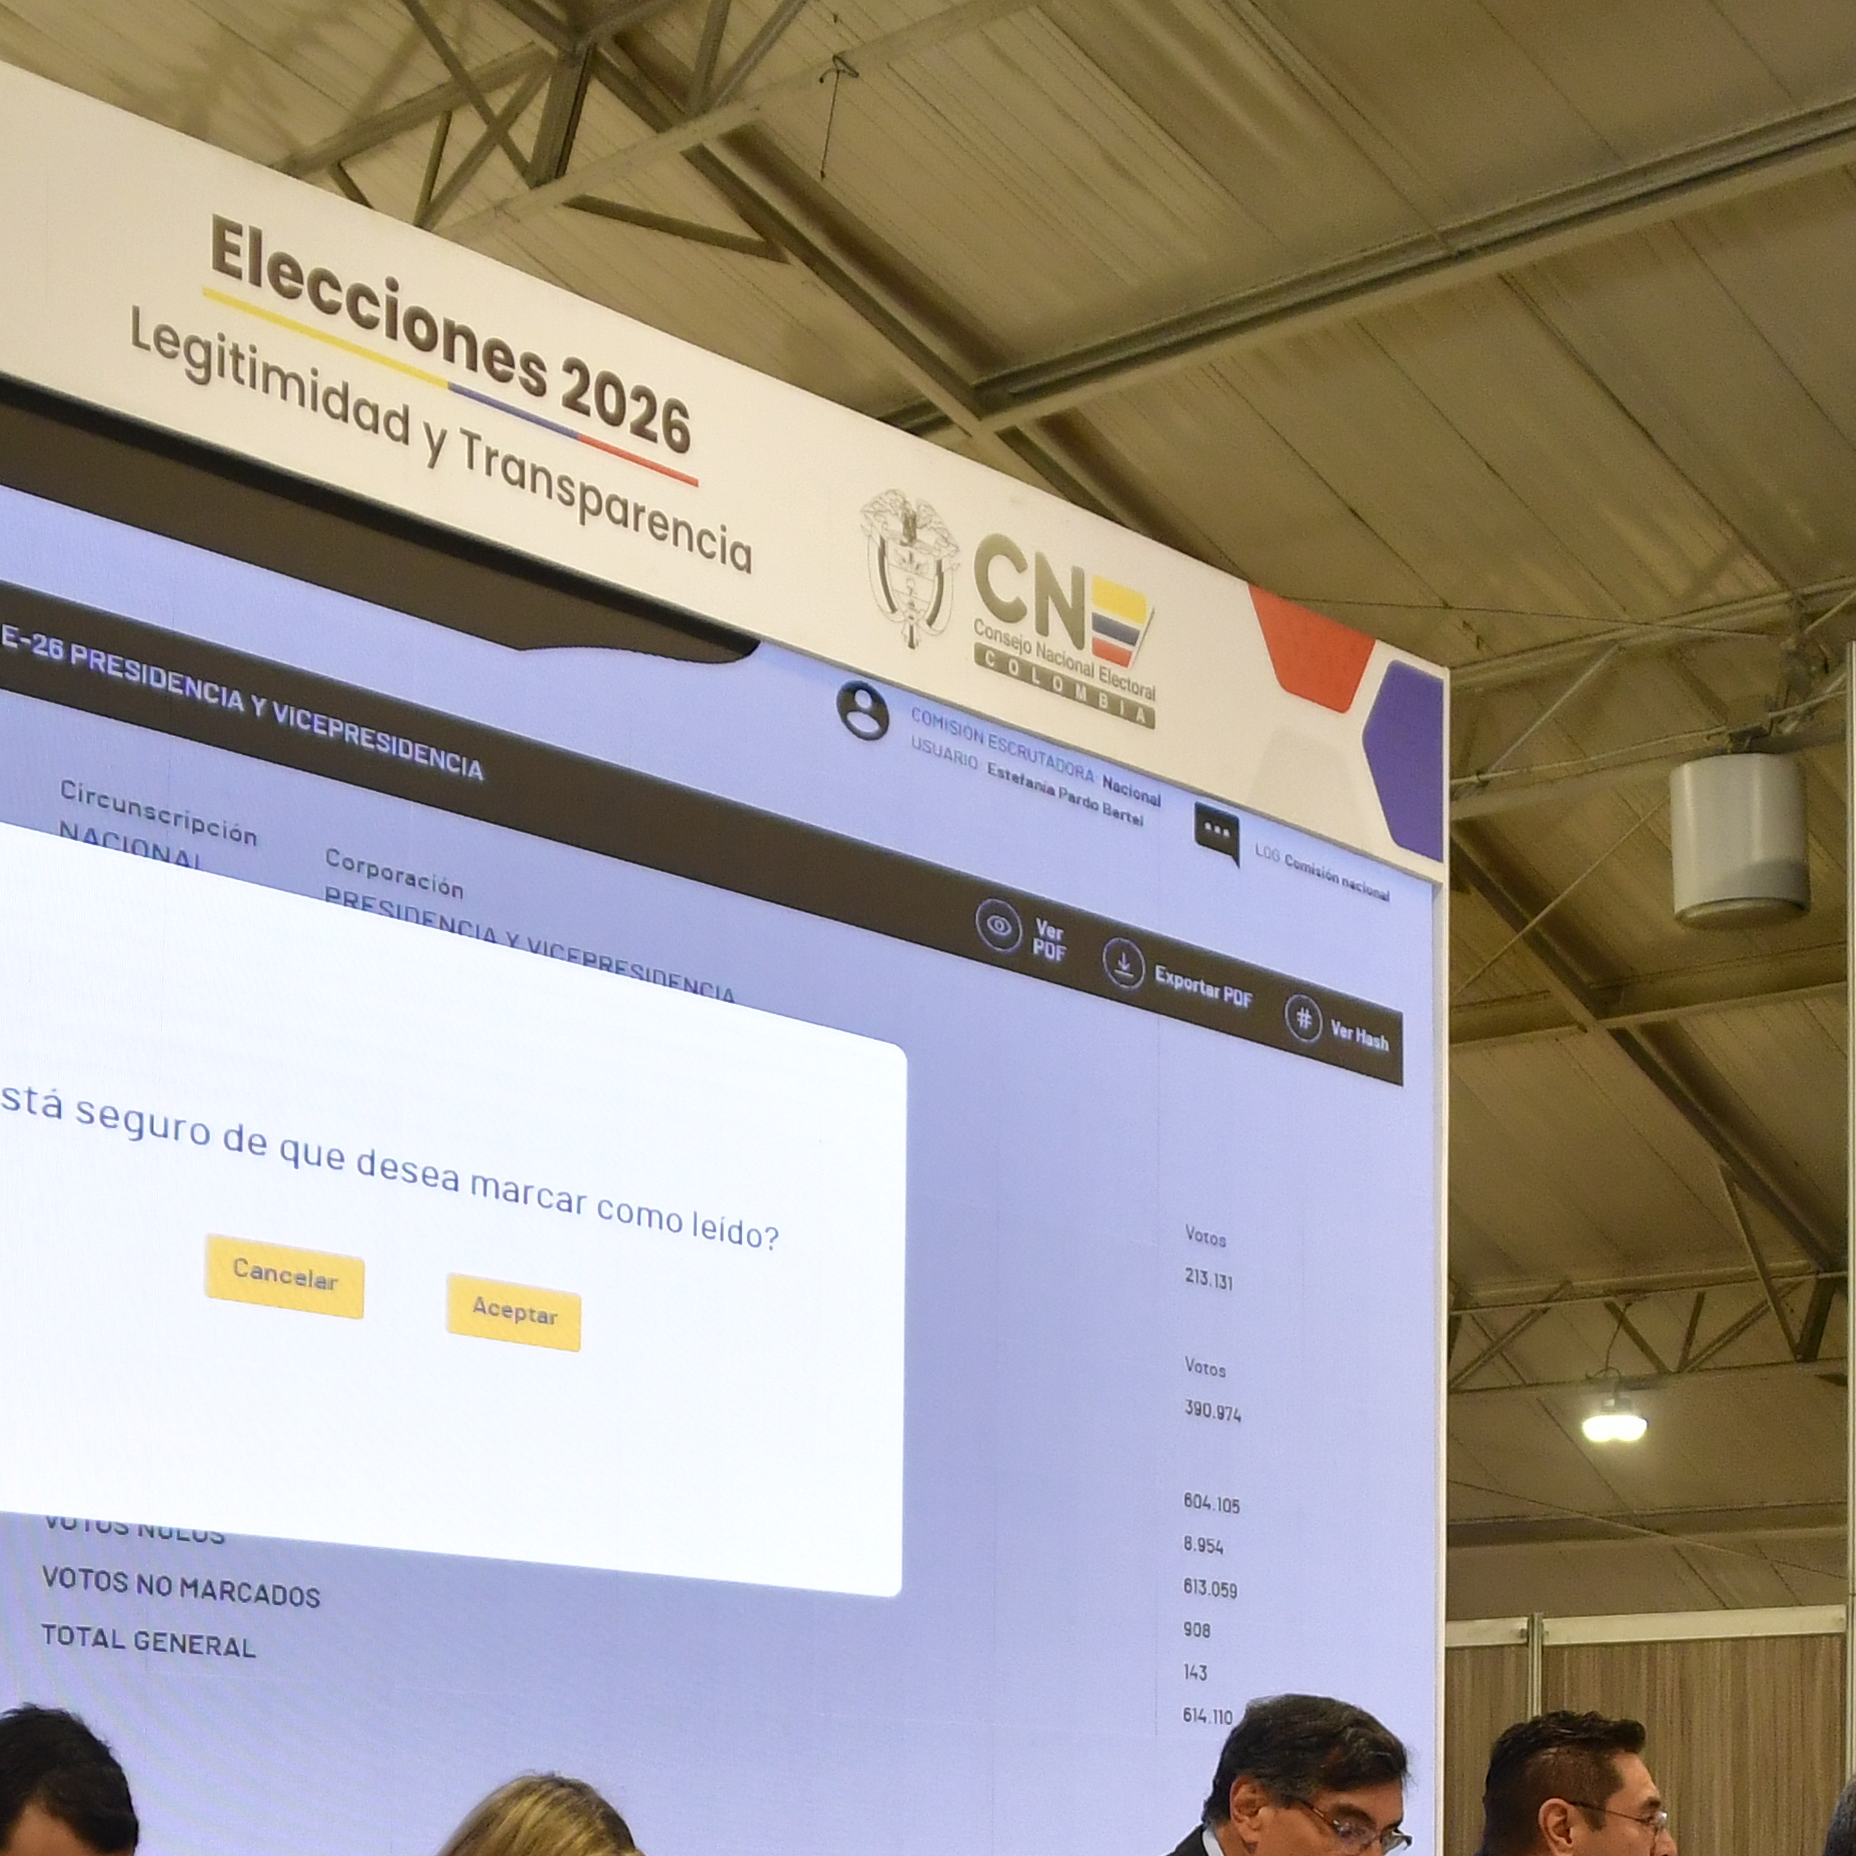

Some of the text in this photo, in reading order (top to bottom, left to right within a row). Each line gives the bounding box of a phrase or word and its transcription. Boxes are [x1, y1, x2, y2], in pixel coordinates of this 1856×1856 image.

[211, 213, 692, 454] Elecciones 2026
[131, 304, 753, 574] Legitimidad y Transparencia
[974, 618, 1156, 702] Consejo Nacional Electoral
[985, 650, 1146, 722] COLOMBIA
[1, 623, 486, 783] E-26 PRESIDENCIA Y VICEPRESIDENCIA
[1103, 774, 1162, 807] Nacional
[60, 779, 258, 847] Circunscripción
[325, 848, 465, 900] Corporación
[1284, 853, 1340, 884] Comisión
[1035, 917, 1064, 941] Ver
[1033, 938, 1068, 963] PDF
[1155, 964, 1254, 1009] Exportar PDF
[1331, 1018, 1391, 1053] Ver Hash
[75, 1099, 211, 1147] seguro
[222, 1121, 269, 1159] de
[280, 1136, 346, 1173] que
[356, 1148, 461, 1194] desea
[470, 1170, 588, 1217] marcar
[597, 1198, 684, 1236] como
[692, 1209, 781, 1253] leído?
[1185, 1224, 1227, 1249] Votos
[232, 1256, 559, 1331] Cancelar Aceptar
[1185, 1268, 1234, 1292] 213.131
[1184, 1355, 1227, 1379] Votos
[1184, 1398, 1243, 1424] 390.974
[1183, 1492, 1242, 1516] 604.105
[1183, 1535, 1225, 1556] 8.954
[42, 1564, 322, 1609] VOTOS NO MARCADOS
[1183, 1578, 1238, 1601] 613.059
[41, 1622, 257, 1659] TOTAL GENERAL
[1183, 1621, 1212, 1640] 908
[1183, 1663, 1209, 1682] 143
[1182, 1708, 1235, 1727] 614.110
